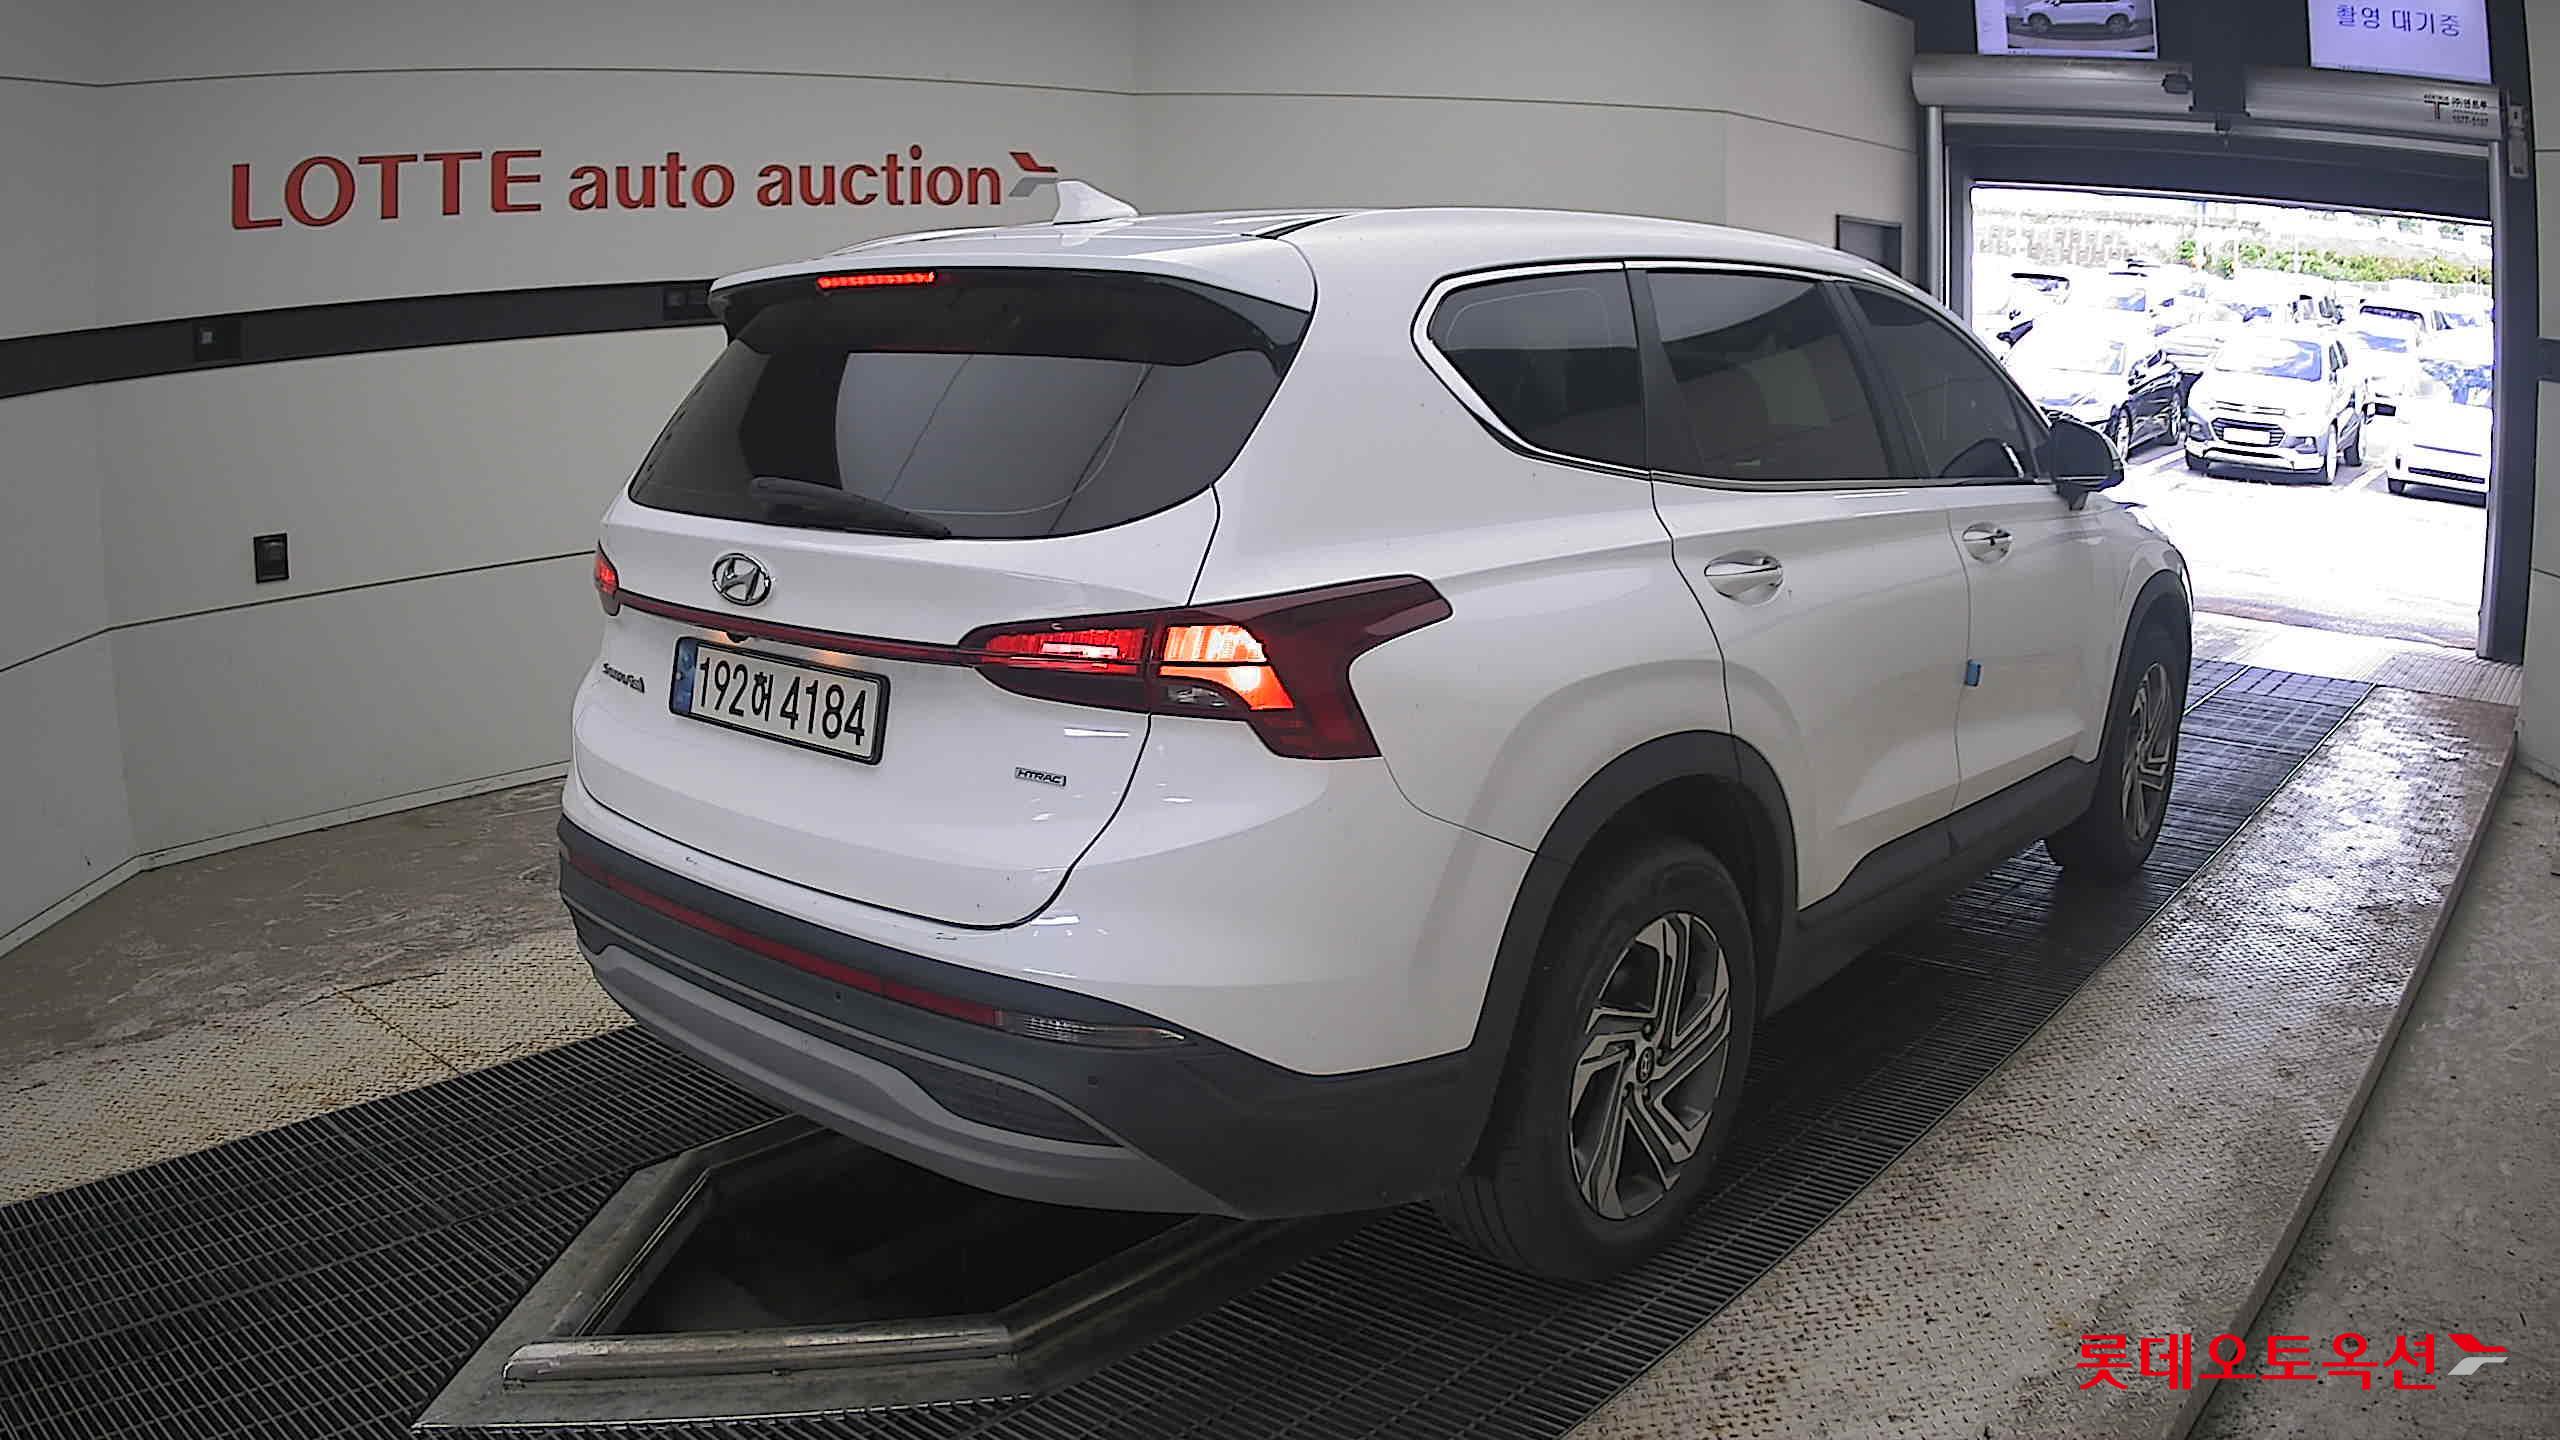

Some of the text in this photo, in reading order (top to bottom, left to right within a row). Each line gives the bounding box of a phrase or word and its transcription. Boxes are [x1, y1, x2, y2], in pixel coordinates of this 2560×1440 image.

[2392, 9, 2461, 37] 대기중
[231, 145, 1002, 230] LOTTE auto auction
[699, 656, 867, 746] 192허 4184
